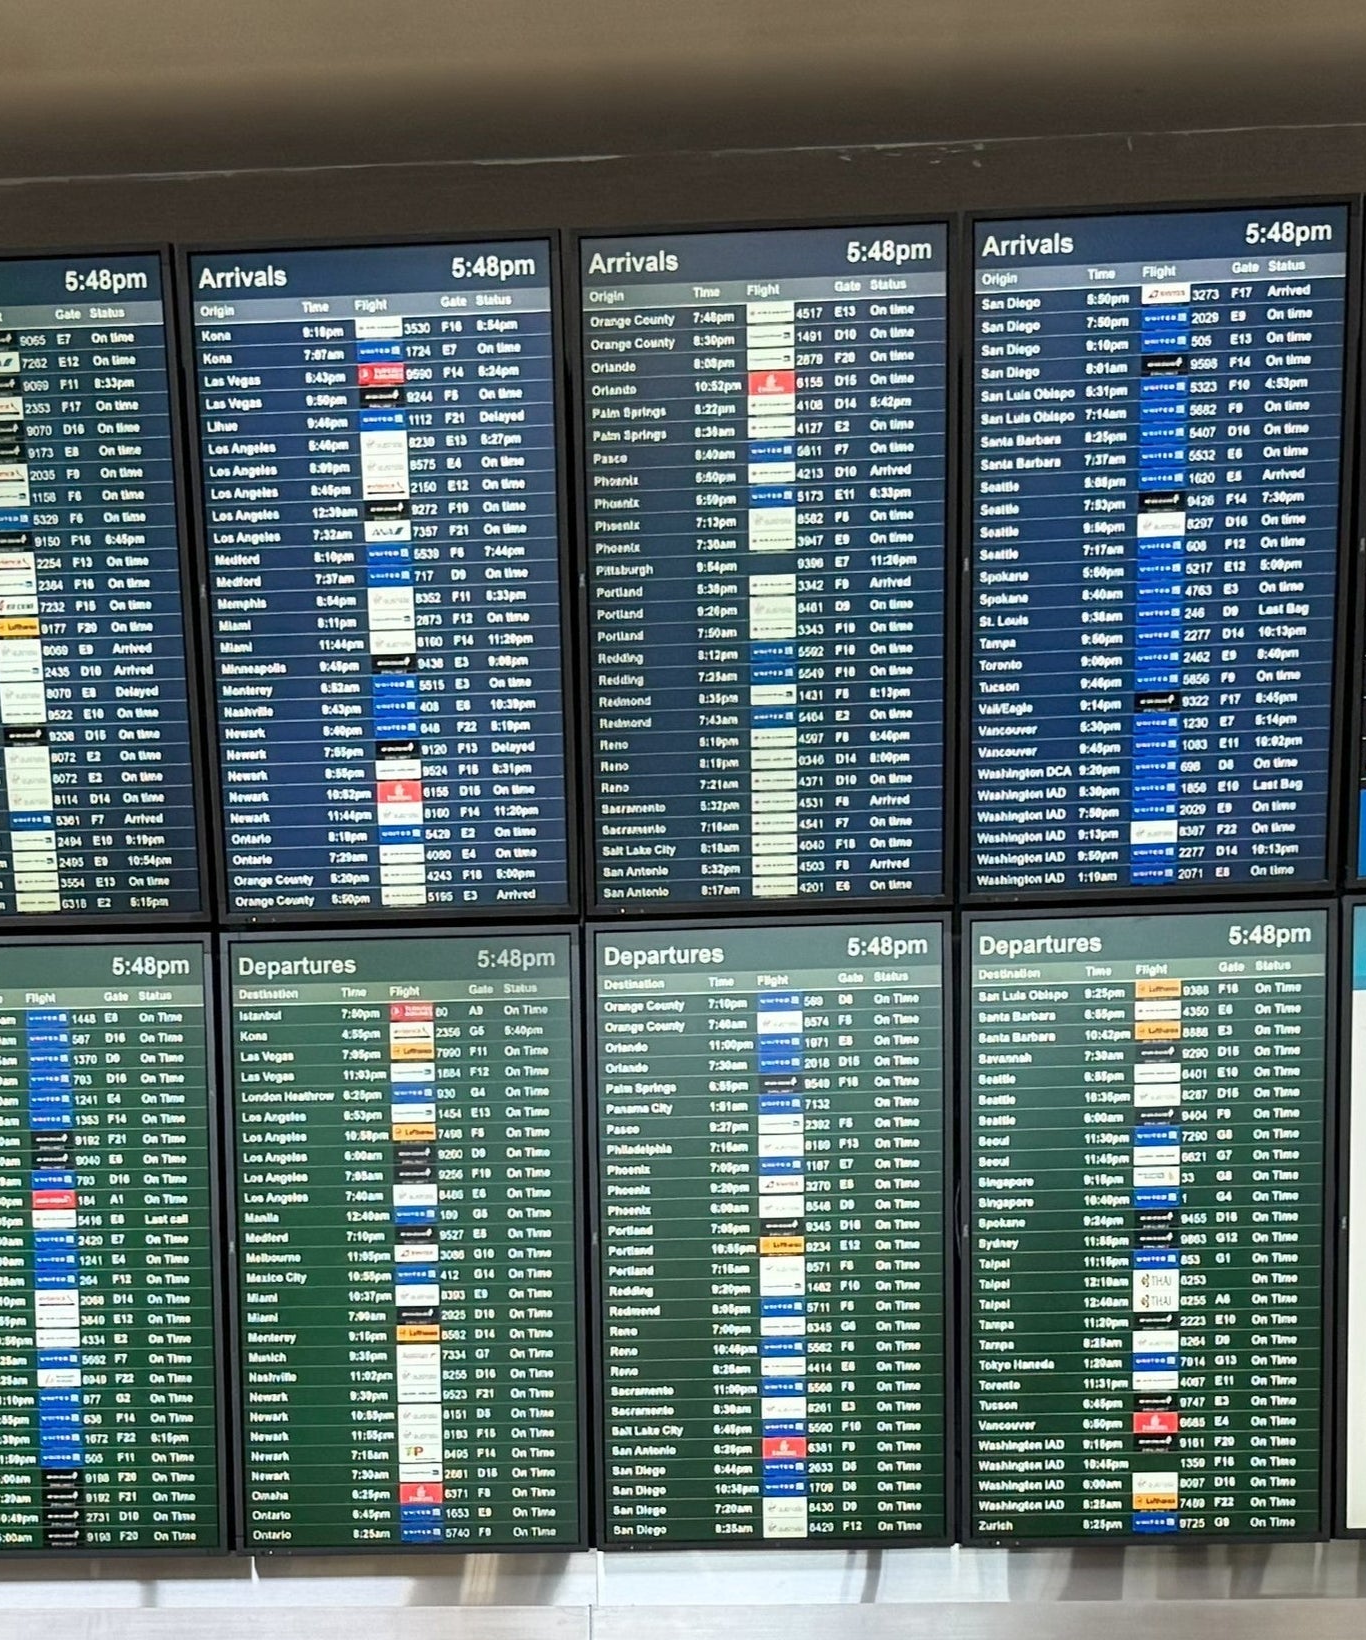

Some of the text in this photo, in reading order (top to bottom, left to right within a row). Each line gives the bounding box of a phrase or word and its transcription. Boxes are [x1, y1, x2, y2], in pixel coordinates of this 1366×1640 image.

[981, 221, 1331, 257] Arrivals 5:48pm
[588, 239, 931, 274] Arrivals 5:48pm
[198, 255, 535, 289] Arrivals 5:48pm
[981, 259, 1305, 287] Origin Time Flight Gate Status
[65, 269, 147, 295] 5:48pm
[589, 278, 906, 304] Origin Time Flight Gate Status
[200, 294, 511, 319] Origin Time Flight Gate Status
[981, 297, 1040, 311] San Diego
[54, 308, 81, 320] Gate
[89, 307, 125, 319] Status
[201, 330, 231, 342] Kona
[408, 413, 432, 426] 1112
[207, 441, 276, 457] Los Angeles
[596, 586, 642, 598] Portland
[978, 659, 1022, 671] Toronto
[978, 681, 1019, 693] Tucson
[979, 924, 1311, 959] Departures 5:48pm
[604, 935, 927, 970] Departures 5:48pm
[112, 956, 189, 980] 5:48pm
[238, 948, 555, 980] Departures 5:48pm
[978, 960, 1291, 980] Destination Time Flight Gate Status
[604, 971, 908, 990] Destination Time Flight Gate Status
[25, 992, 55, 1006] Flight
[103, 991, 128, 1002] Gate
[138, 990, 172, 1001] Status
[238, 983, 537, 1000] Destination Time Flight Gate Status
[239, 1010, 281, 1022] Istanbul
[240, 1051, 294, 1064] Las Vegas
[613, 1524, 666, 1537] San Diego
[978, 1520, 1013, 1531] Zurich
[252, 1530, 291, 1541] Ontario
